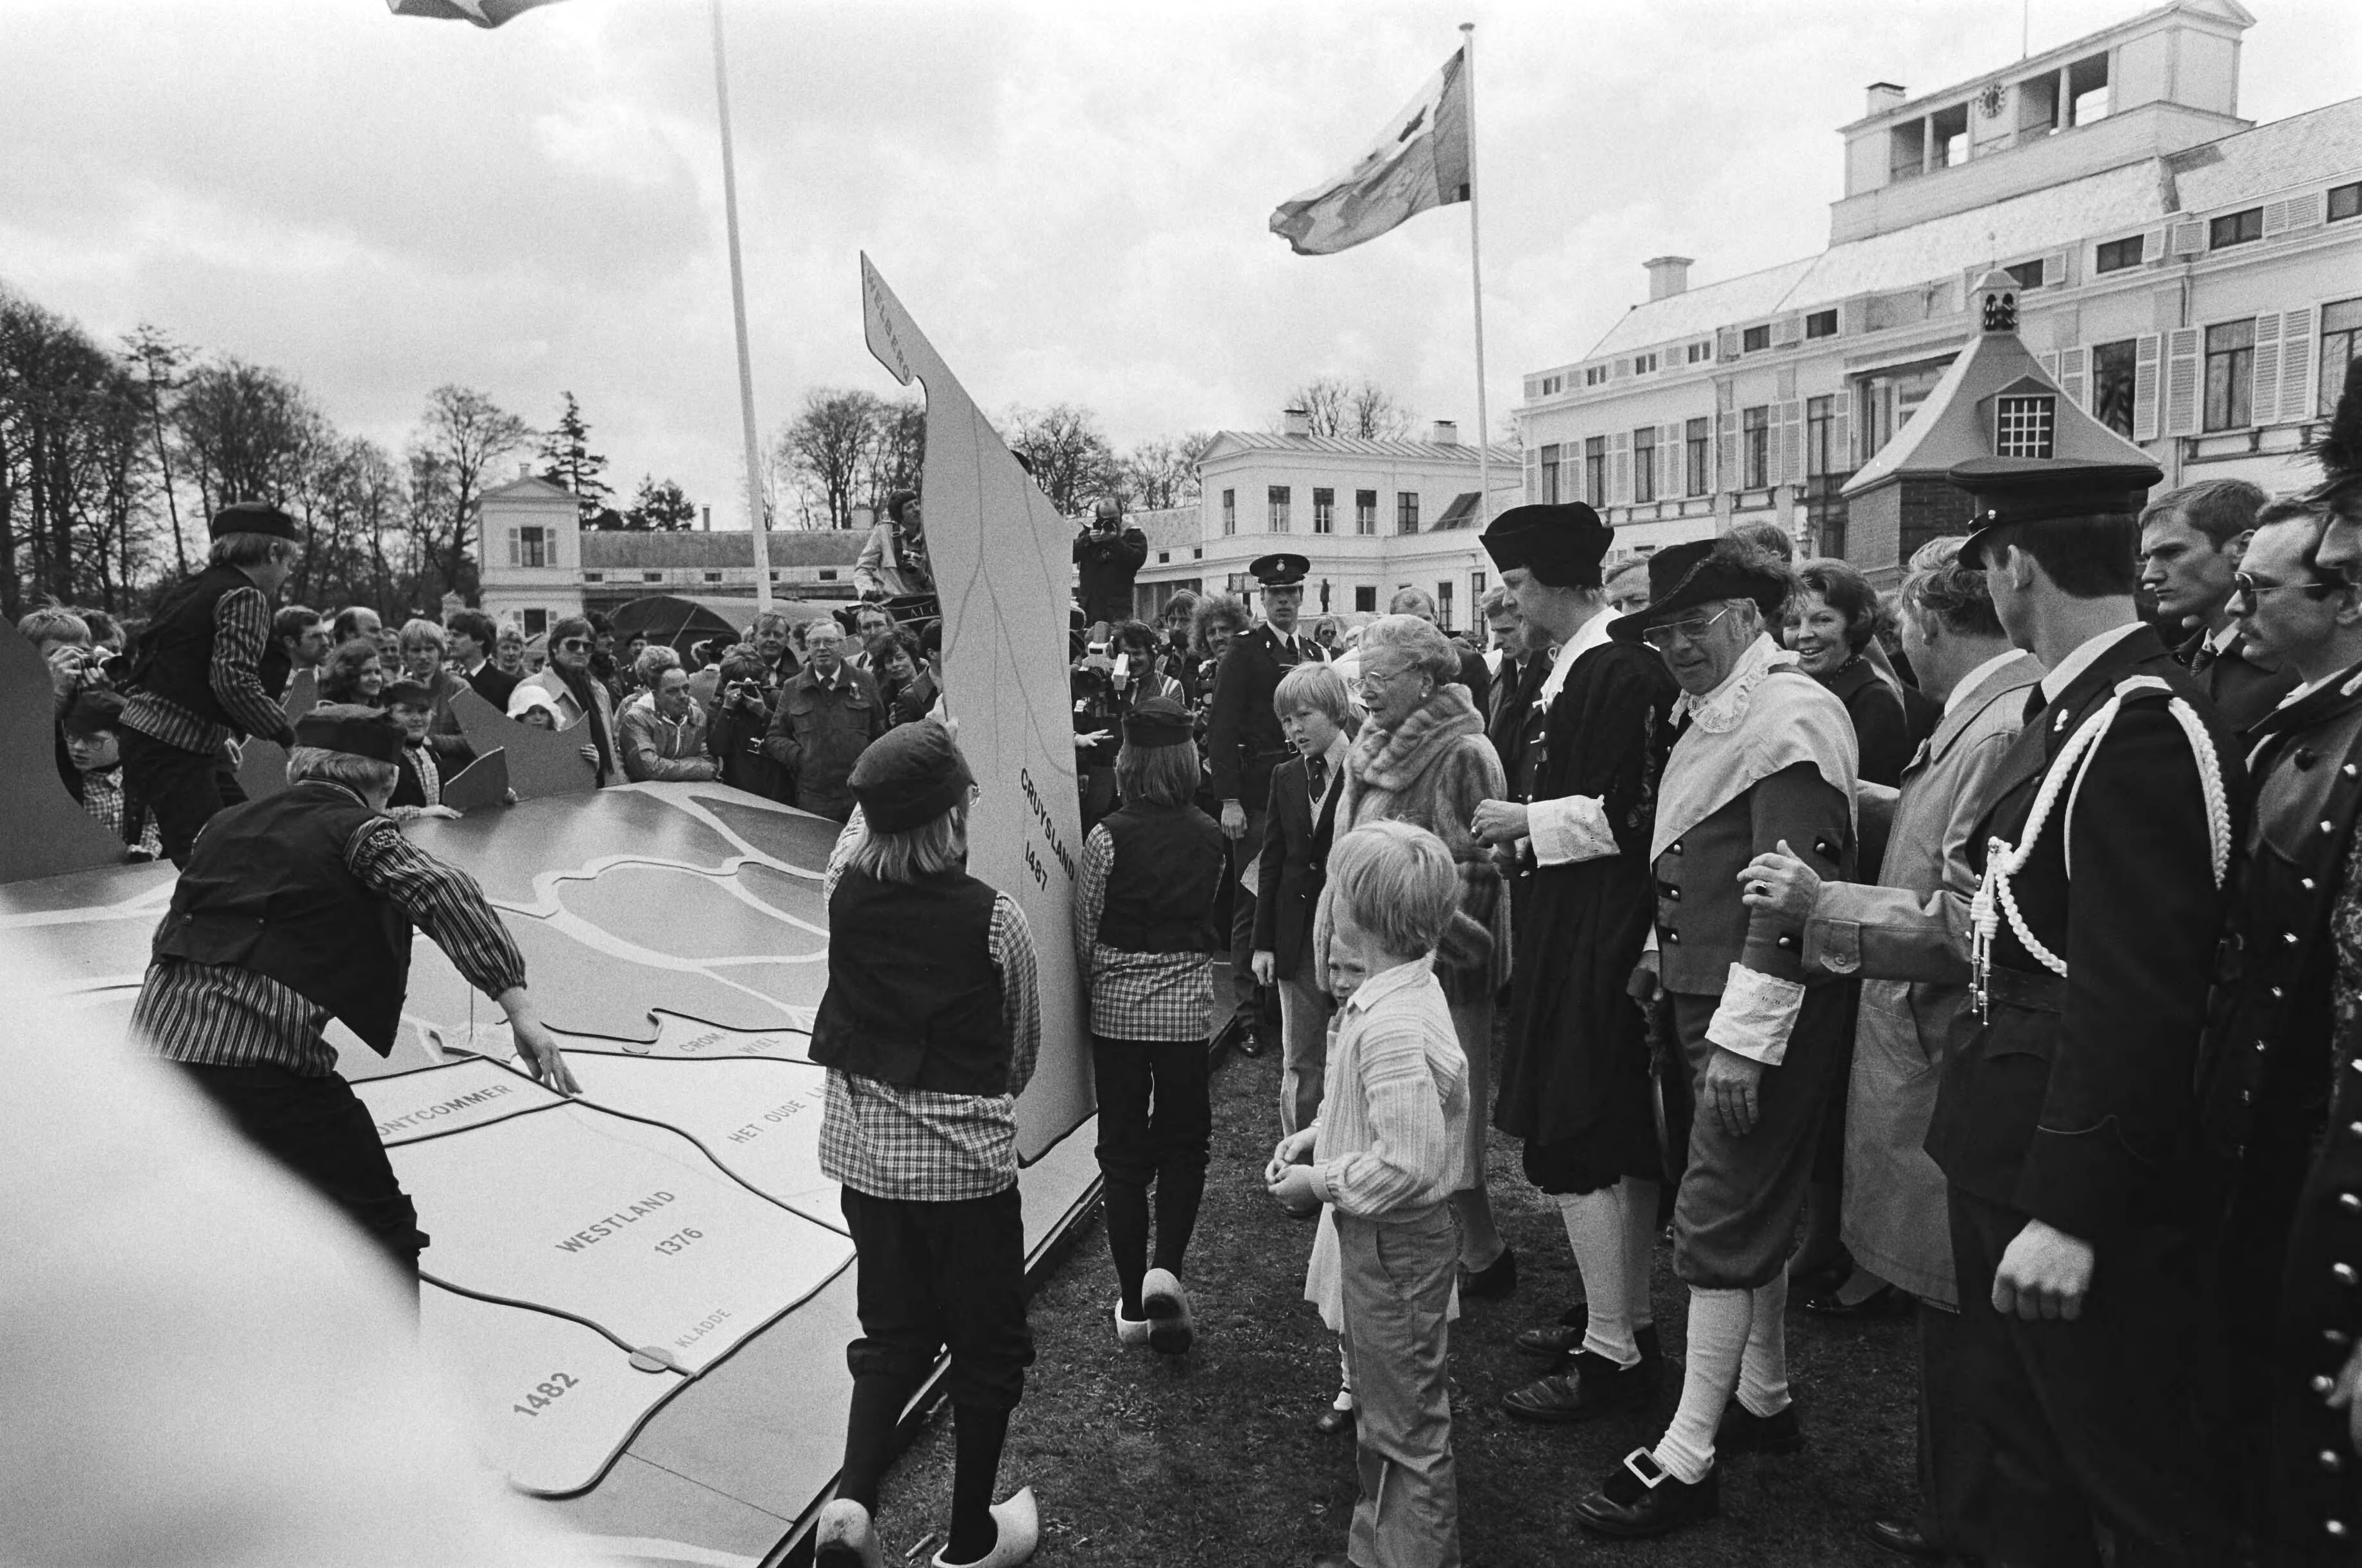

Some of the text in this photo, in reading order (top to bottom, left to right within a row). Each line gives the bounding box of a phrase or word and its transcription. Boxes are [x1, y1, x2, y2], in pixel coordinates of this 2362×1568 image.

[1021, 768, 1074, 881] CRUYSLAND
[1026, 841, 1047, 891] 1487
[738, 1037, 780, 1054] WIEL
[727, 1123, 764, 1144] HET
[764, 1099, 806, 1123] OUDE
[555, 1191, 677, 1254] WESTLAND
[654, 1227, 704, 1257] 1376
[674, 1307, 733, 1348] KLADDE
[513, 1372, 580, 1417] 1482
